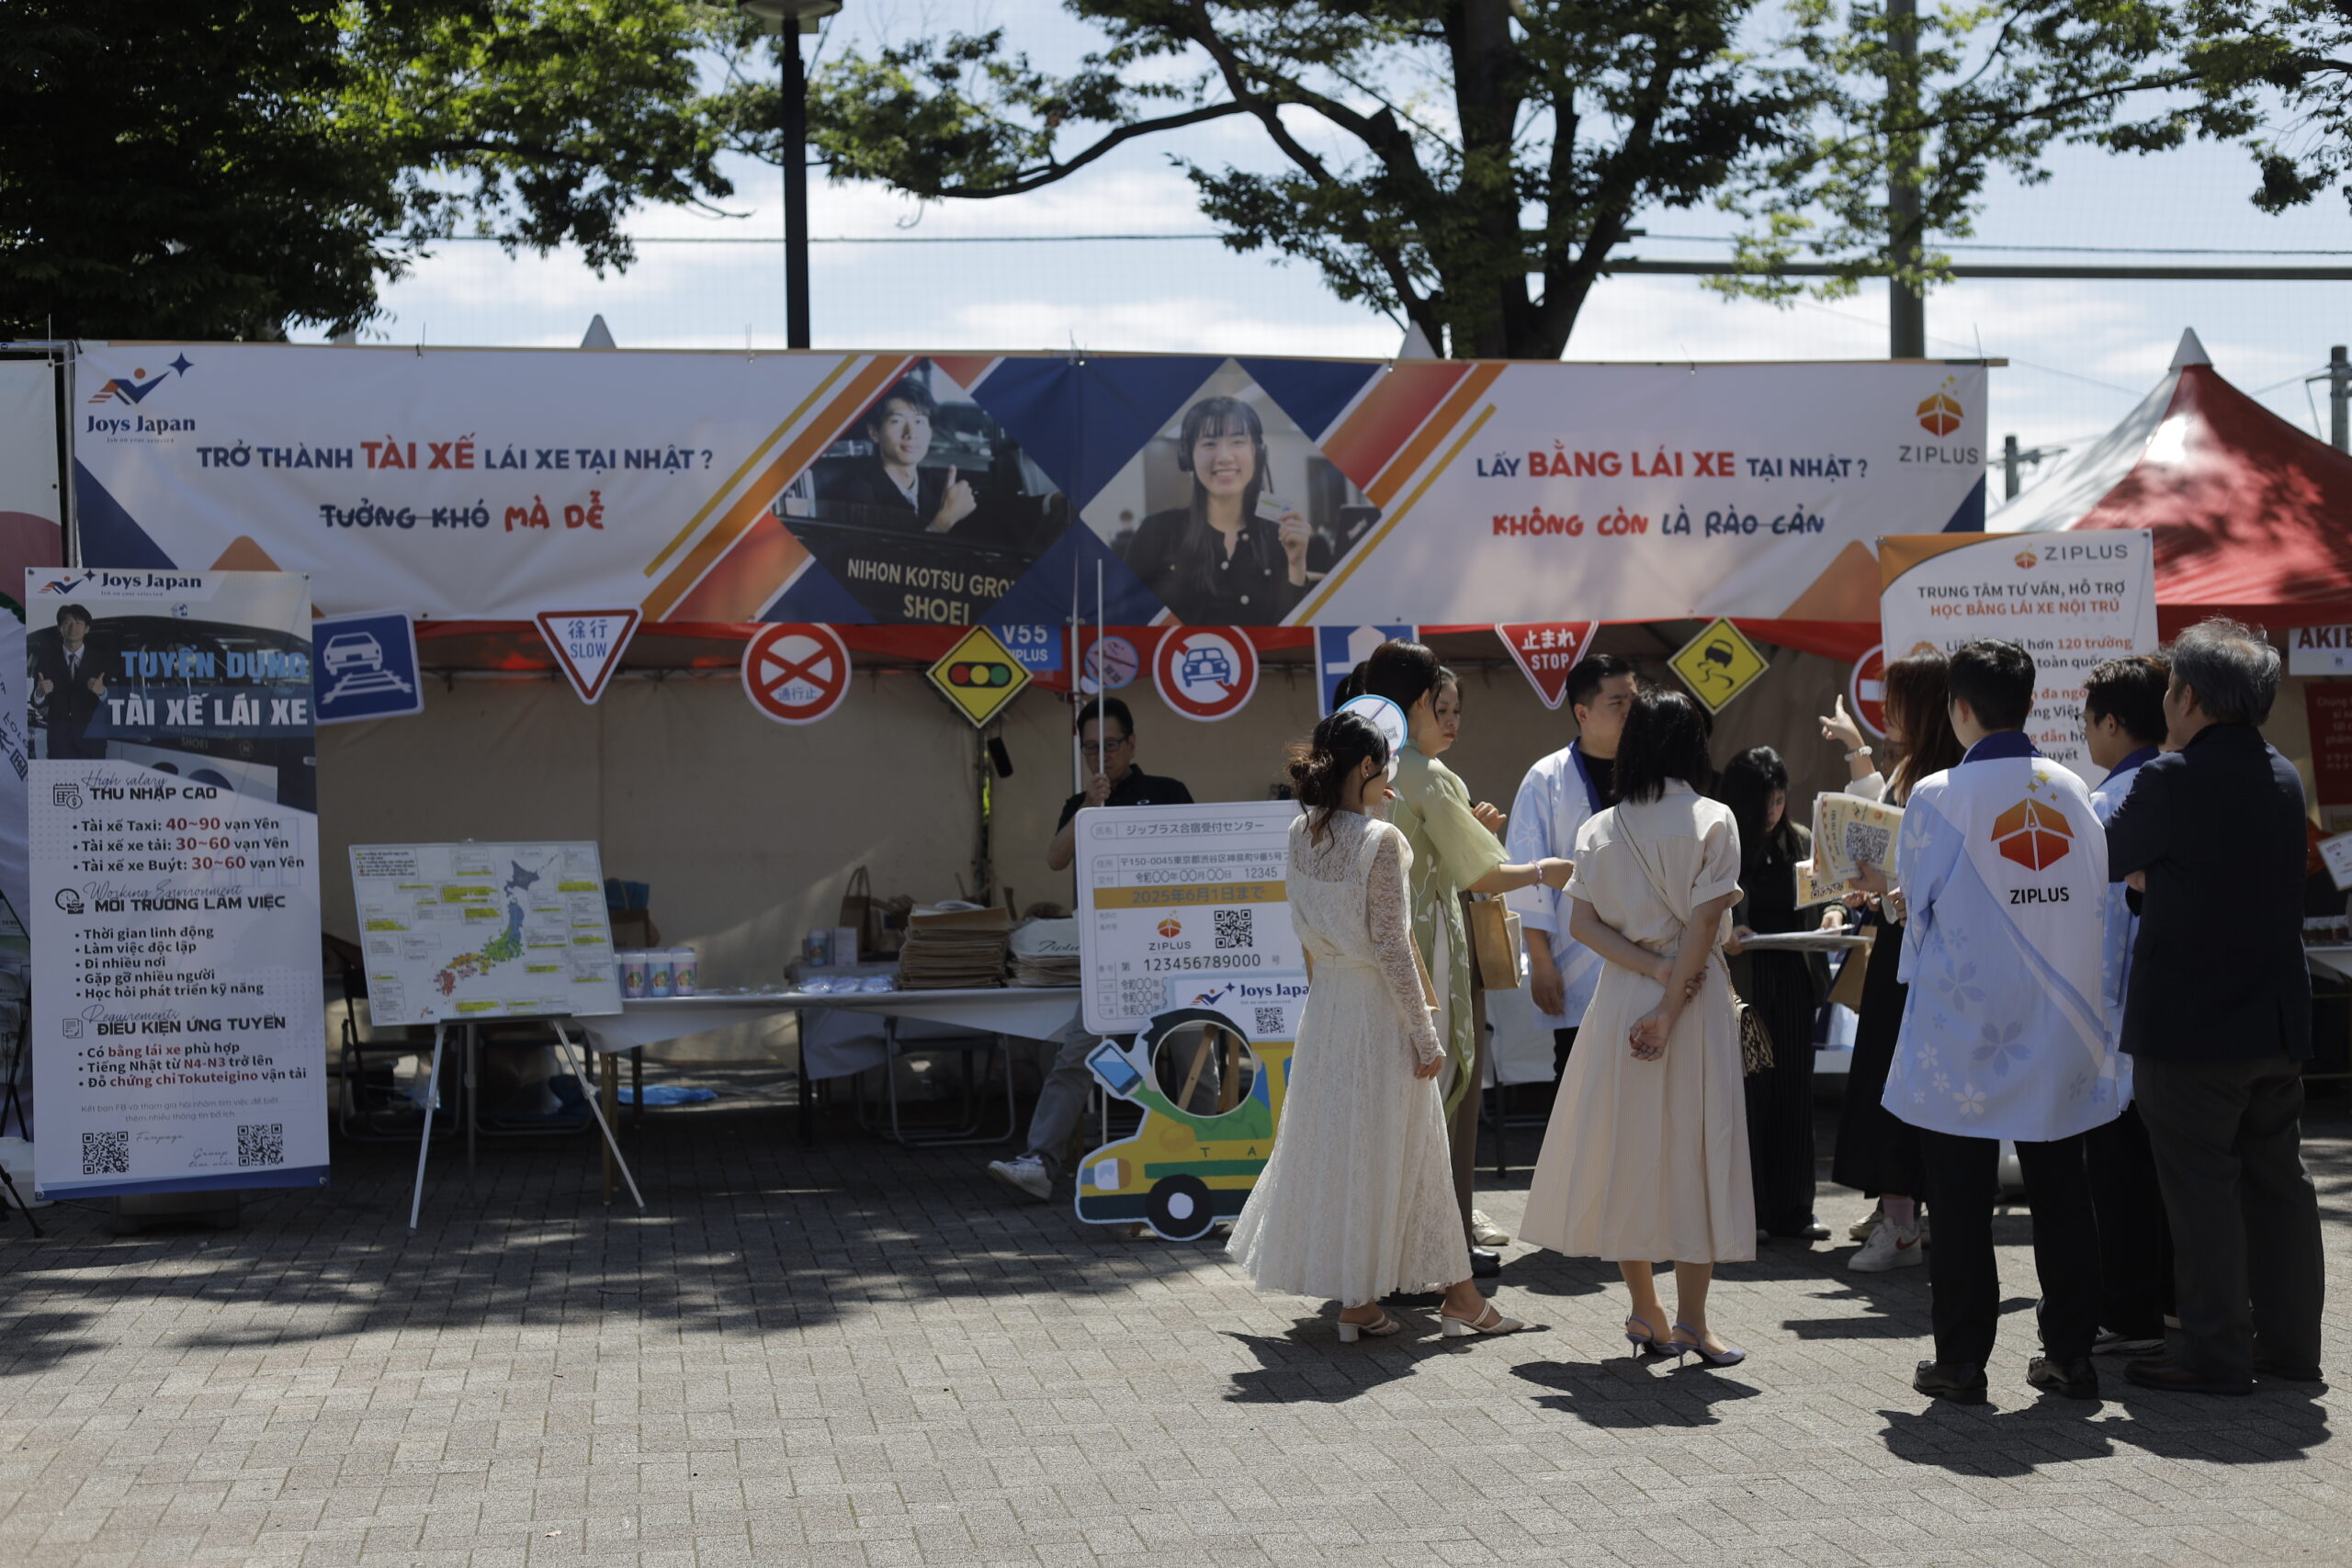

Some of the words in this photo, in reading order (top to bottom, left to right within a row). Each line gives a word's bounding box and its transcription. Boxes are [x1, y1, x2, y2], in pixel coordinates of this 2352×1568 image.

[86, 415, 130, 434] Joys
[137, 416, 196, 435] Japan
[197, 439, 251, 468] TRỞ
[257, 443, 353, 469] THÀNH
[360, 434, 416, 469] TÀI
[427, 432, 476, 469] XẾ
[484, 444, 526, 469] LÁI
[536, 449, 570, 469] XE
[575, 449, 616, 474] TẠI
[624, 444, 695, 475] NHẬT
[701, 449, 713, 469] ?
[1476, 451, 1521, 477] LẤY
[1529, 439, 1622, 477] BẰNG
[1631, 445, 1683, 477] LÁI
[1693, 452, 1736, 477] XE
[1747, 458, 1782, 482] TẠI
[1790, 455, 1850, 482] NHẬT
[1856, 459, 1868, 477] ?
[1899, 445, 1979, 466] ZIPLUS
[432, 498, 490, 529] KHÓ
[504, 494, 549, 532] MÀ
[564, 490, 605, 529] DỄ
[1491, 506, 1583, 536] KHÔNG
[1596, 506, 1648, 536] CÒN
[1661, 505, 1690, 536] LÀ
[1704, 503, 1758, 537] RÀO
[1771, 503, 1825, 536] CẢN
[2043, 545, 2129, 561] ZIPLUS
[101, 572, 141, 591] Joys
[145, 574, 202, 592] Japan
[847, 558, 900, 584] NIHON
[905, 566, 965, 593] KOTSU
[969, 575, 1015, 599] GRO
[1918, 585, 1969, 598] TRUNG
[1974, 581, 2003, 598] TÂM
[2007, 582, 2028, 597] TƯ
[2030, 579, 2065, 599] VẤN,
[2070, 578, 2092, 594] HỖ
[2097, 581, 2126, 596] TRỢ
[903, 593, 970, 626] SHOEI
[1931, 605, 1962, 620] HỌC
[1966, 600, 2007, 615] BẰNG
[2011, 600, 2033, 615] LÁI
[2038, 603, 2055, 615] XE
[2060, 598, 2086, 615] NỘI
[2090, 597, 2120, 613] TRÚ
[569, 620, 607, 639] 徐行
[1002, 625, 1047, 644] V55
[1521, 628, 1577, 650] 止まれ
[2027, 637, 2053, 650] hơn
[2058, 638, 2081, 649] 120
[2085, 636, 2132, 650] trường
[571, 643, 607, 659] SLOW
[121, 645, 215, 678] TUYỂN
[227, 651, 309, 684] DỤNG
[1531, 653, 1569, 671] STOP
[2037, 655, 2067, 668] toàn
[108, 693, 154, 726] TÀI
[166, 694, 209, 726] XẾ
[214, 693, 260, 726] LÁI
[270, 699, 308, 726] XE
[81, 768, 121, 790] High
[126, 772, 168, 788] salary
[90, 787, 124, 800] THU
[183, 786, 217, 799] CAO
[82, 821, 102, 831] Tài
[107, 818, 123, 831] xế
[128, 820, 162, 830] Taxi:
[166, 818, 220, 830] 40~90
[224, 820, 250, 832] vạn
[254, 818, 279, 829] Yên
[82, 840, 102, 852] Tài
[107, 839, 123, 852] xế
[128, 843, 143, 852] xe
[147, 839, 171, 851] tải:
[175, 837, 230, 851] 30~60
[234, 840, 260, 852] vạn
[264, 837, 288, 849] Yên
[83, 861, 102, 871] Tài
[107, 859, 123, 871] xế
[148, 859, 187, 873] Buýt:
[191, 857, 245, 871] 30~60
[250, 860, 276, 871] vạn
[279, 857, 304, 869] Yên
[1244, 867, 1278, 880] 12345
[83, 880, 149, 900] Working
[156, 879, 243, 900] Environment
[1132, 886, 1264, 904] 2025年6月1日まで
[2009, 886, 2070, 905] ZIPLUS
[84, 928, 114, 940] Thời
[117, 928, 147, 942] gian
[150, 926, 175, 939] linh
[179, 925, 214, 939] động
[85, 942, 113, 954] Làm
[117, 942, 144, 956] việc
[147, 941, 172, 954] độc
[175, 940, 197, 954] lập
[1037, 940, 1080, 953] Ziplu
[1148, 942, 1192, 952] ZIPLUS
[85, 958, 98, 969] Đi
[102, 956, 141, 969] nhiều
[144, 956, 166, 967] nơi
[1144, 954, 1261, 971] 123456789000
[85, 972, 111, 986] Gặp
[115, 971, 132, 986] gỡ
[135, 971, 173, 983] nhiều
[176, 968, 216, 982] người
[85, 988, 109, 1002] Học
[114, 987, 136, 998] hỏi
[140, 987, 170, 1000] phát
[174, 985, 208, 997] triển
[210, 983, 227, 997] kỹ
[231, 984, 264, 996] năng
[1240, 984, 1272, 998] Joys
[1276, 983, 1309, 998] Japa
[82, 1004, 180, 1022] Requirements
[187, 1015, 221, 1032] ỨNG
[87, 1047, 105, 1058] Có
[108, 1044, 141, 1058] bằng
[145, 1044, 163, 1056] lái
[165, 1046, 181, 1055] xe
[185, 1043, 211, 1056] phù
[215, 1042, 240, 1055] hợp
[87, 1061, 126, 1075] Tiếng
[130, 1060, 163, 1073] Nhật
[166, 1058, 181, 1070] từ
[185, 1057, 226, 1068] N4-N3
[229, 1056, 249, 1067] trở
[253, 1055, 273, 1066] lên
[110, 1074, 153, 1089] chứng
[179, 1070, 258, 1084] Tokuteigino
[262, 1069, 286, 1081] vận
[289, 1067, 307, 1078] tải
